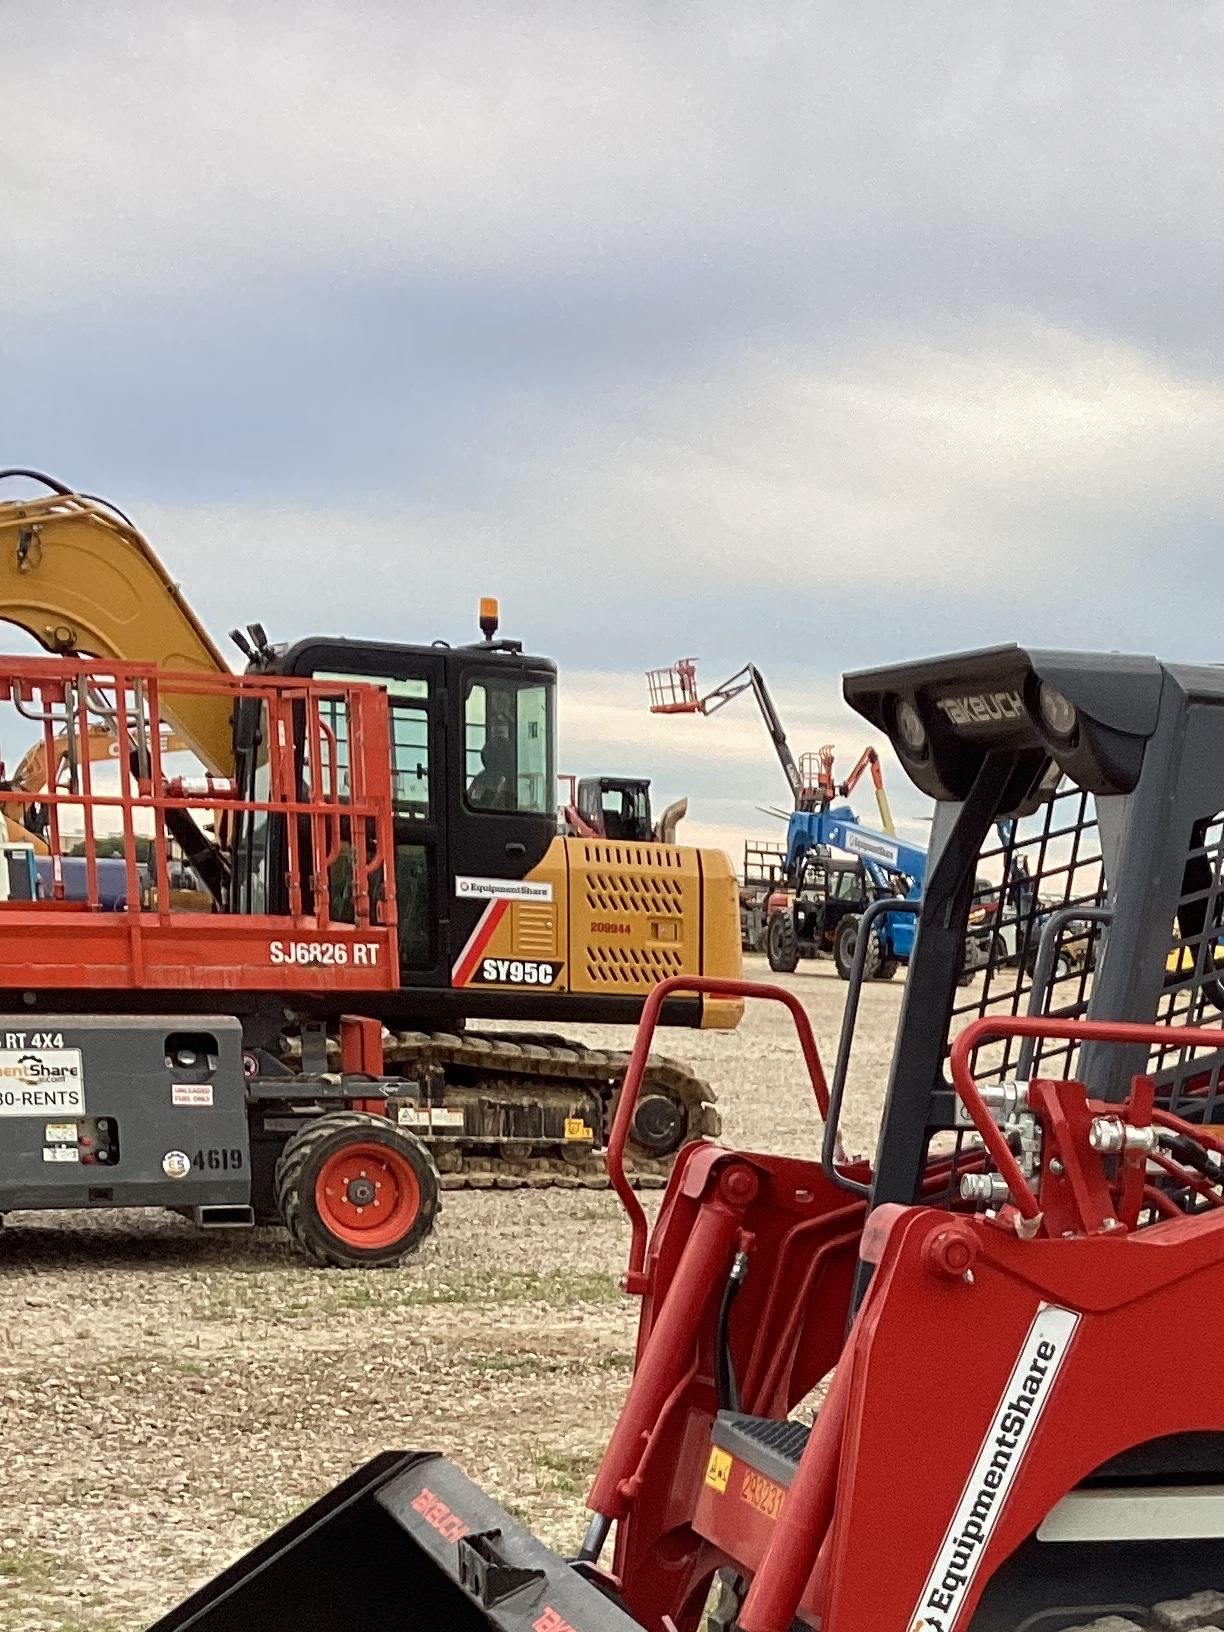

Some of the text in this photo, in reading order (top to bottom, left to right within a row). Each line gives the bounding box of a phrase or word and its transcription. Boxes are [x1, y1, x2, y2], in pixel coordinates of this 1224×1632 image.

[590, 922, 631, 935] 209944
[269, 941, 380, 965] SJ6826 RT
[482, 959, 553, 985] SY95C
[5, 1032, 64, 1048] RT 4X4
[0, 1063, 78, 1077] entShare
[192, 1148, 243, 1171] 4619
[926, 1338, 1057, 1615] EquipmentShare
